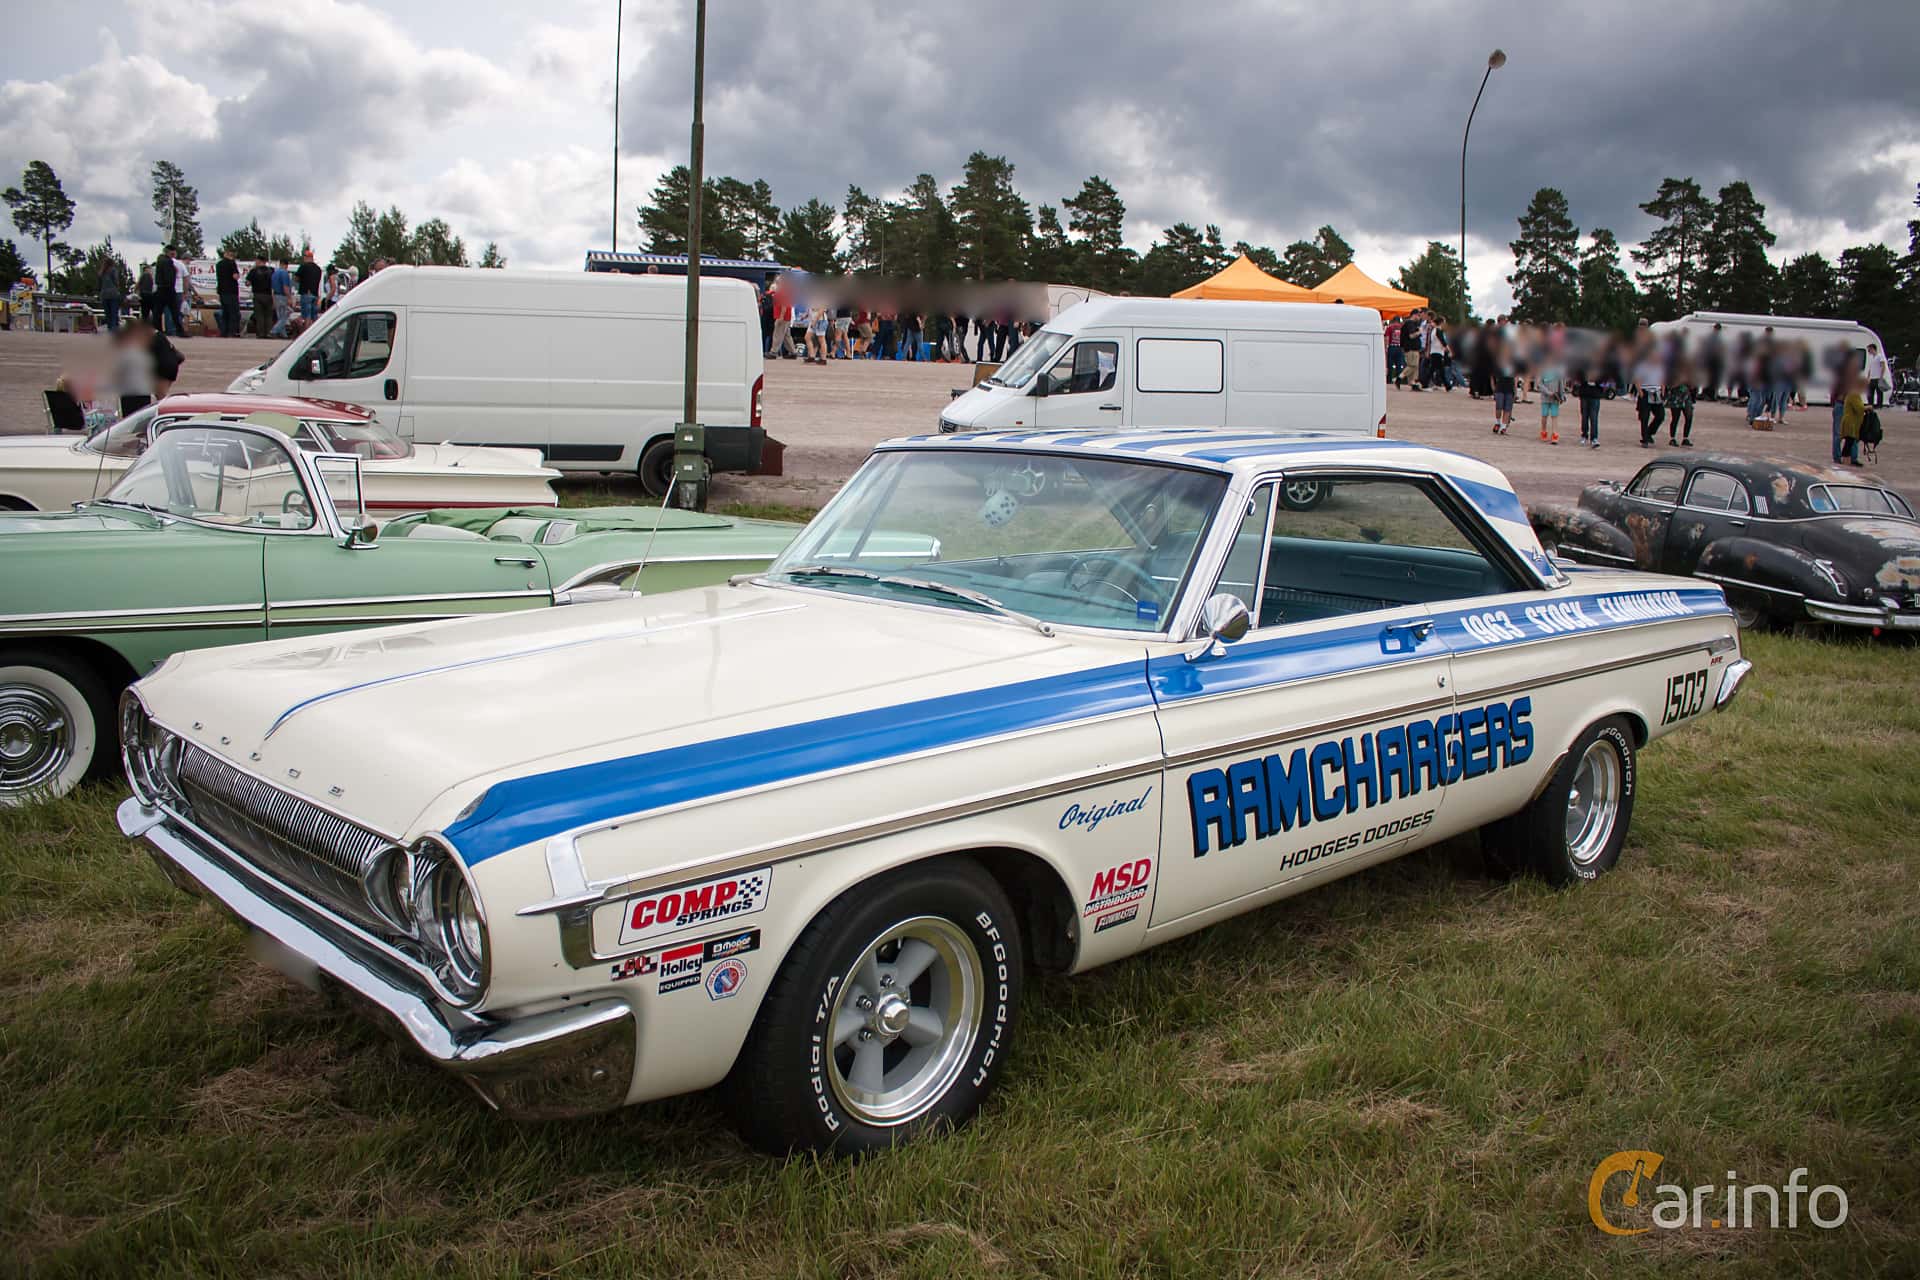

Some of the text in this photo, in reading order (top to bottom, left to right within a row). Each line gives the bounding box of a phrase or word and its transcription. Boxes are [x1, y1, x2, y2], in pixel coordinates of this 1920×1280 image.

[1460, 591, 1694, 644] 1963 STOCK ELIMINATOR
[1661, 668, 1708, 726] 1503
[1186, 695, 1535, 858] RAMCHARGERS
[1058, 785, 1153, 832] Original
[1280, 809, 1435, 871] HODGES DODGES
[1084, 887, 1146, 915] DISTRIBUTOR
[1089, 858, 1152, 901] MSD
[630, 881, 738, 930] COMP
[675, 899, 753, 926] SPRINGS
[659, 957, 703, 978] Holley
[660, 976, 701, 992] EQUIPPED
[974, 912, 1008, 1088] BFGoodrich
[811, 975, 840, 1132] Radial T/A
